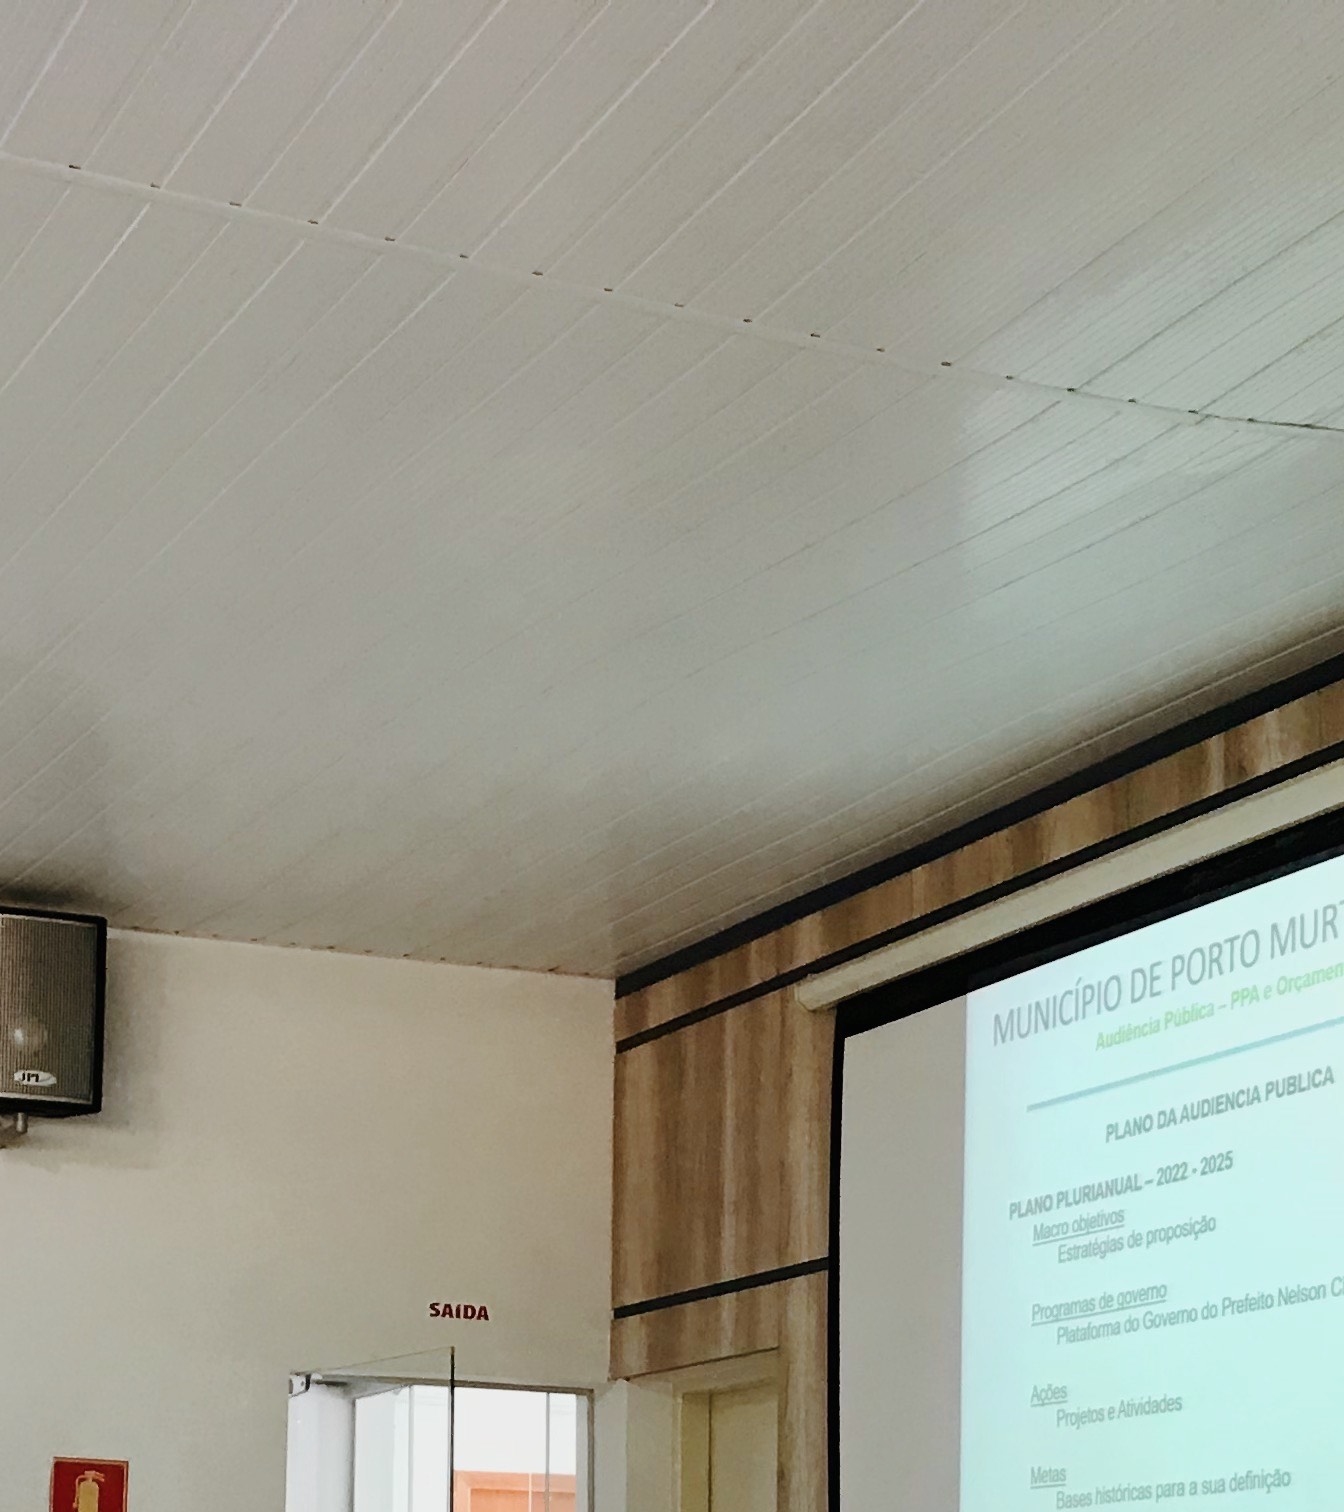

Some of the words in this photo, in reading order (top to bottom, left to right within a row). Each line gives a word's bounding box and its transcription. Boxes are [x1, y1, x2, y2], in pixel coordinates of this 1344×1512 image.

[993, 976, 1122, 1047] MUNICÍPIO
[1130, 961, 1163, 1004] DE
[1171, 928, 1261, 992] PORTO
[1095, 1017, 1161, 1051] Audiência
[1164, 1000, 1215, 1031] Pública
[1230, 985, 1260, 1011] PPA
[1263, 984, 1273, 1000] e
[1105, 1112, 1154, 1143] PLANO
[1157, 1107, 1178, 1130] DA
[1179, 1084, 1262, 1125] AUDIENCIA
[1265, 1065, 1335, 1102] PUBLICA
[1009, 1193, 1054, 1220] PLANO
[1056, 1173, 1143, 1210] PLURIANUAL
[1156, 1161, 1188, 1187] 2022
[1200, 1150, 1234, 1177] 2025
[1033, 1219, 1069, 1243] Macro
[1071, 1208, 1125, 1235] objetivos
[1058, 1233, 1124, 1264] Estratégias
[1127, 1229, 1143, 1249] de
[1146, 1215, 1217, 1249] proposição
[1031, 1297, 1096, 1321] Programas
[1098, 1291, 1114, 1310] de
[1116, 1284, 1168, 1309] governo
[1056, 1320, 1121, 1345] Plataforma
[1124, 1316, 1140, 1333] do
[1142, 1307, 1198, 1331] Governo
[1201, 1301, 1218, 1321] do
[1221, 1291, 1275, 1317] Prefeito
[1278, 1283, 1327, 1307] Nelson
[1056, 1406, 1105, 1430] Projetos
[1107, 1406, 1115, 1421] e
[1117, 1394, 1183, 1419] Atividades
[1030, 1465, 1067, 1485] Metas
[1056, 1490, 1093, 1510] Bases
[1095, 1483, 1153, 1505] históricas
[1156, 1481, 1185, 1502] para
[1188, 1480, 1198, 1496] a
[1202, 1477, 1226, 1495] sua
[1229, 1469, 1292, 1494] definição
